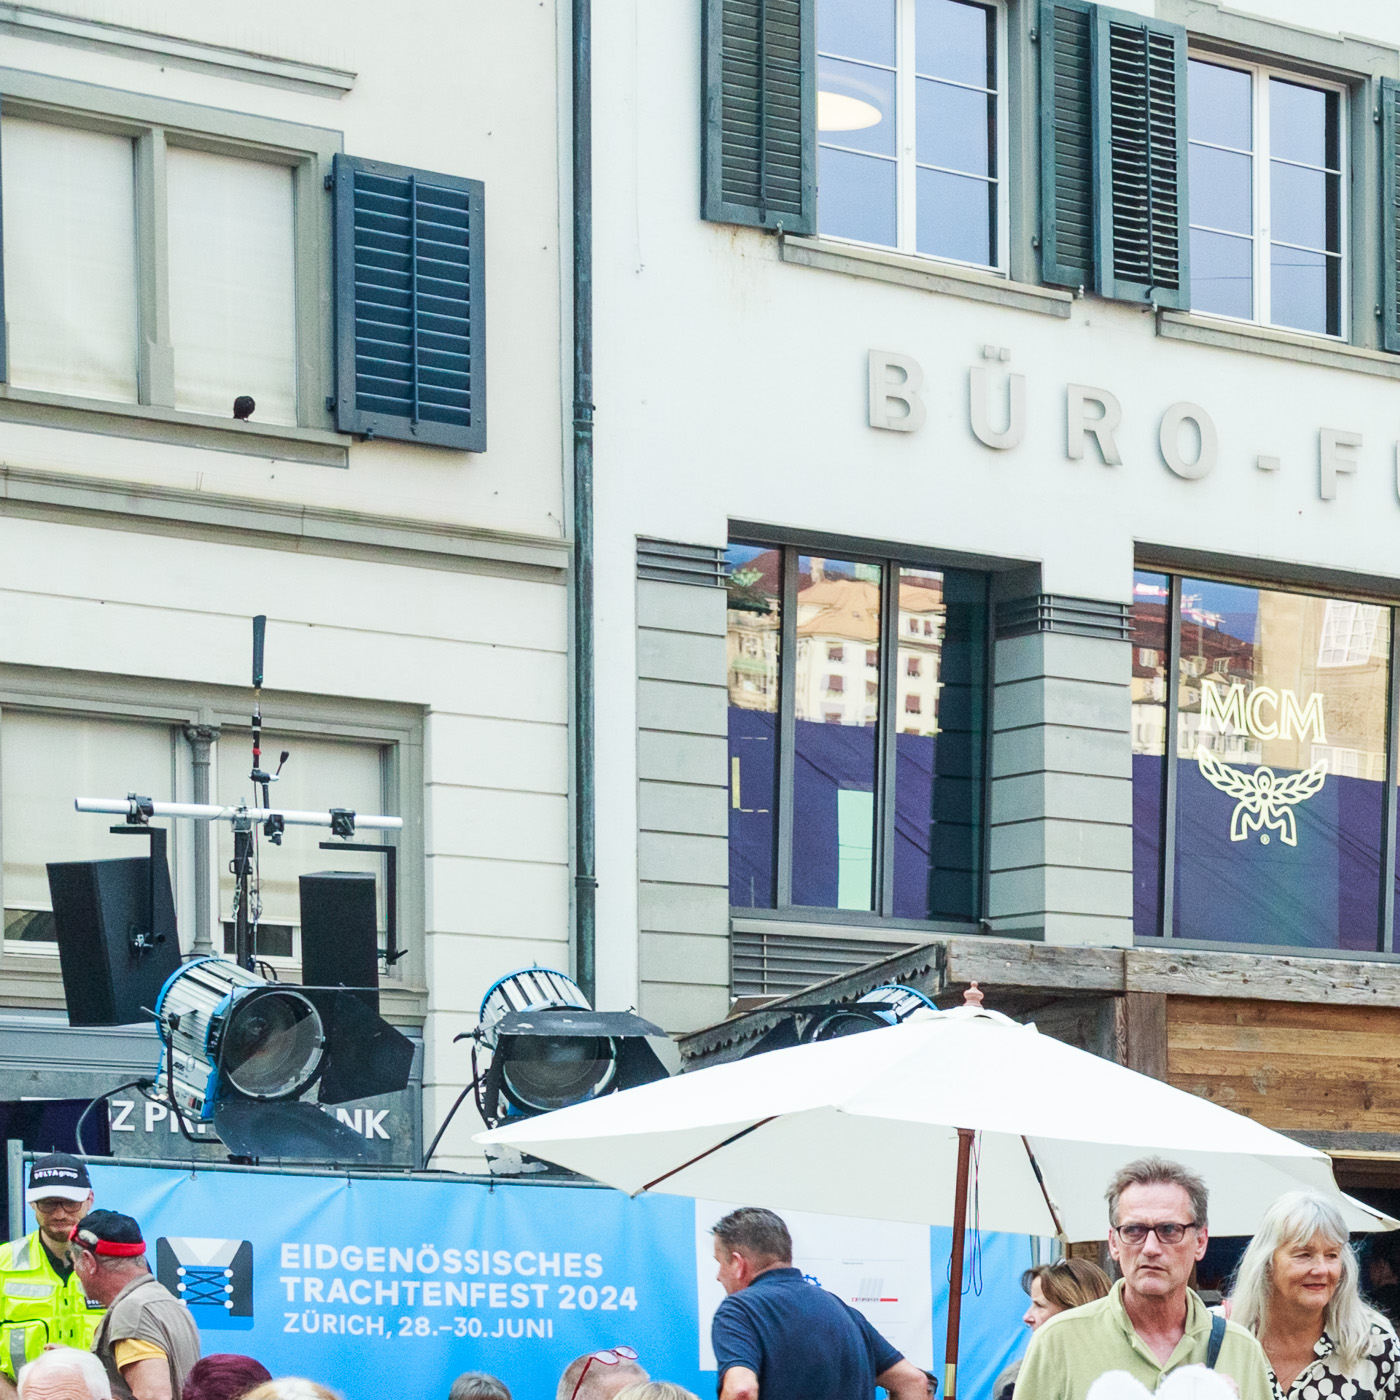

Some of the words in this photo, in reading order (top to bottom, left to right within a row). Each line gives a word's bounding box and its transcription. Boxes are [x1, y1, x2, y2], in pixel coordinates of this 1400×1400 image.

[1198, 679, 1328, 744] MCM
[279, 1242, 603, 1279] EIDGENÖSSISCHES
[280, 1276, 549, 1309] TRACHTENFEST
[557, 1284, 638, 1311] 2024
[283, 1310, 392, 1340] ZÜRICH,
